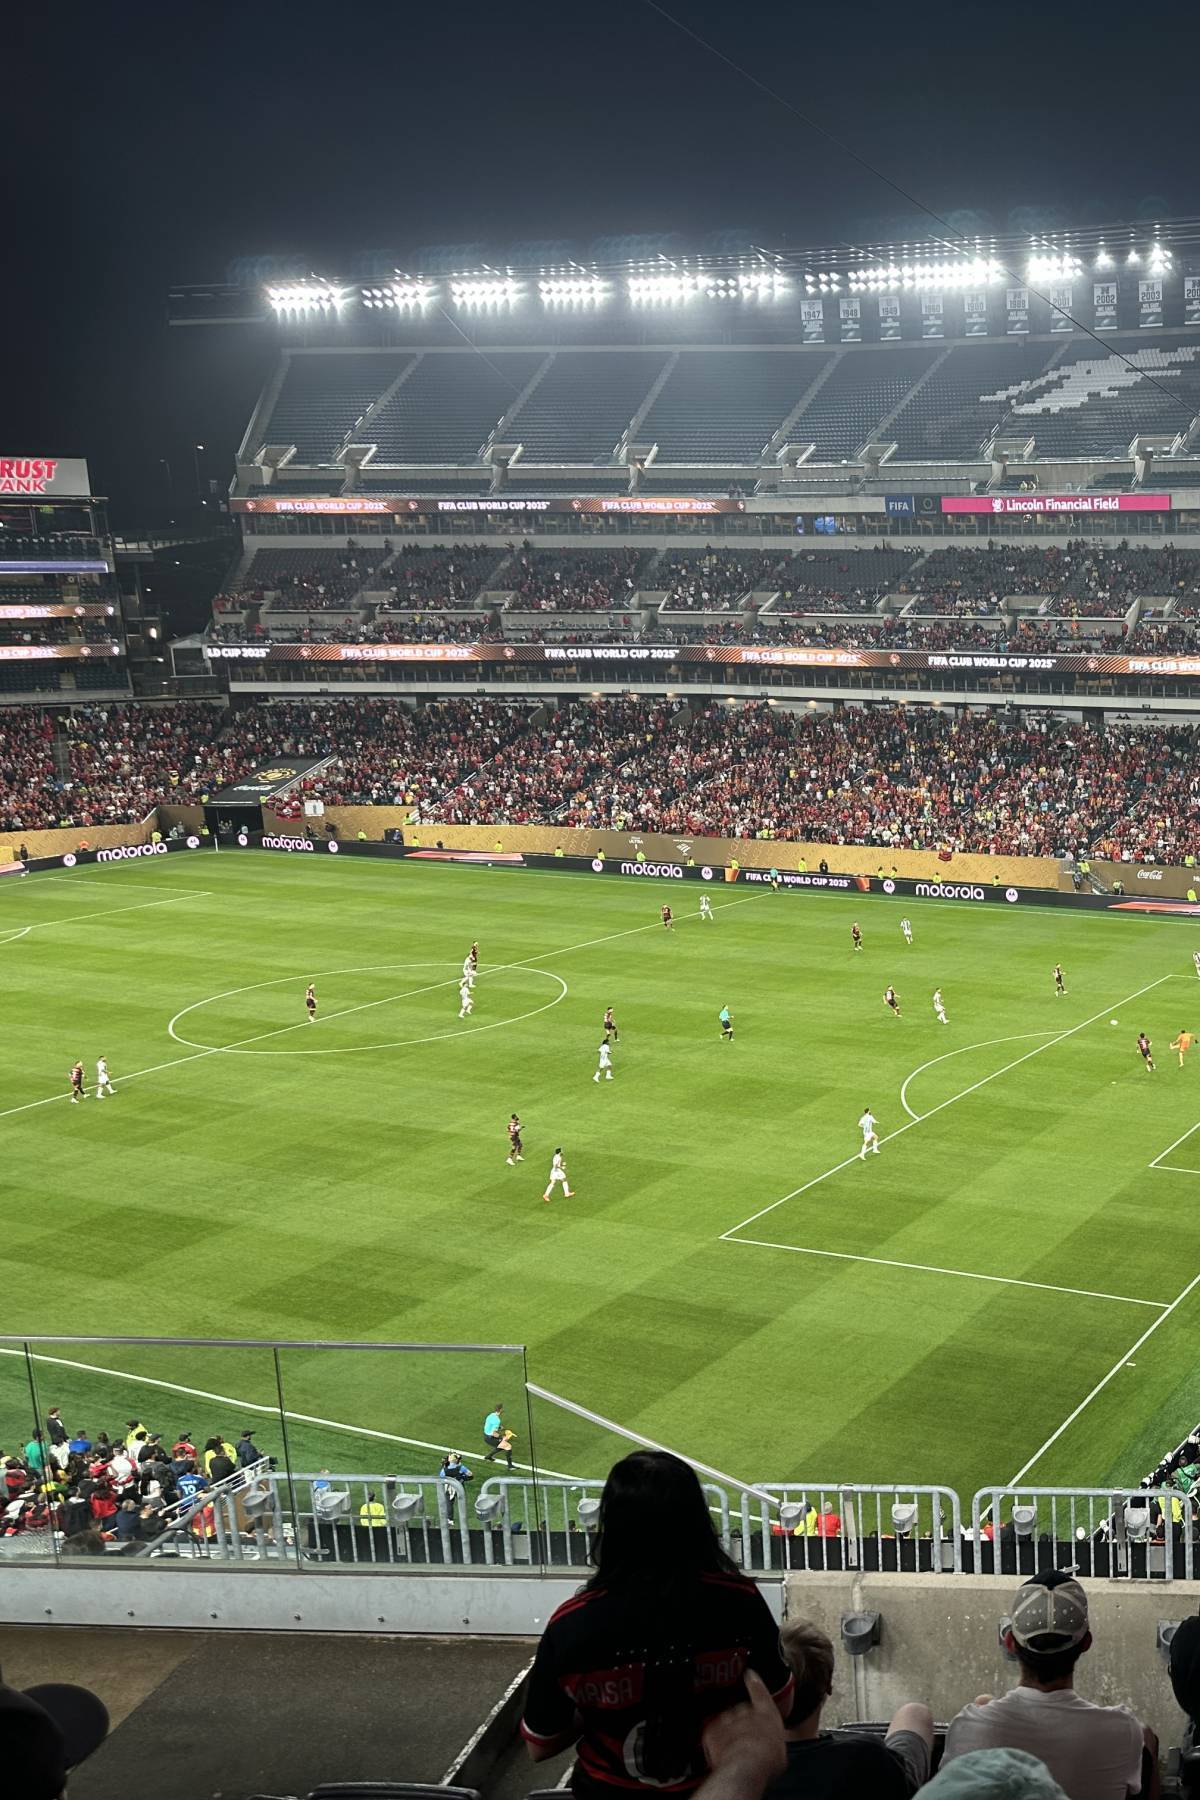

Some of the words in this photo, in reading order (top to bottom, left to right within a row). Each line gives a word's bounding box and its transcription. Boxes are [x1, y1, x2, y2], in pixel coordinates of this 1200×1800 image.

[0, 480, 46, 492] ANK
[438, 501, 456, 510] FIFA
[457, 501, 477, 510] CLUB
[478, 501, 508, 510] WORLD
[509, 501, 526, 510] CUP
[889, 501, 909, 511] FIFA
[1006, 499, 1043, 511] Lincoln
[1045, 498, 1092, 511] Financial
[1094, 497, 1119, 510] Field
[221, 647, 241, 657] CUP
[545, 648, 566, 658] FIFA
[566, 648, 592, 658] CLUB
[593, 648, 628, 658] WORLD
[629, 648, 649, 658] CUP
[928, 656, 948, 666] FIFA
[949, 657, 973, 666] CLUB
[974, 657, 1007, 667] WORLD
[1008, 658, 1028, 668] CUP
[262, 836, 314, 851] motorola
[97, 841, 168, 862] motorola
[621, 862, 683, 878] motorola
[745, 872, 762, 882] FIFA
[784, 875, 811, 885] WORLD
[812, 877, 828, 886] CUP
[916, 883, 985, 901] motorola
